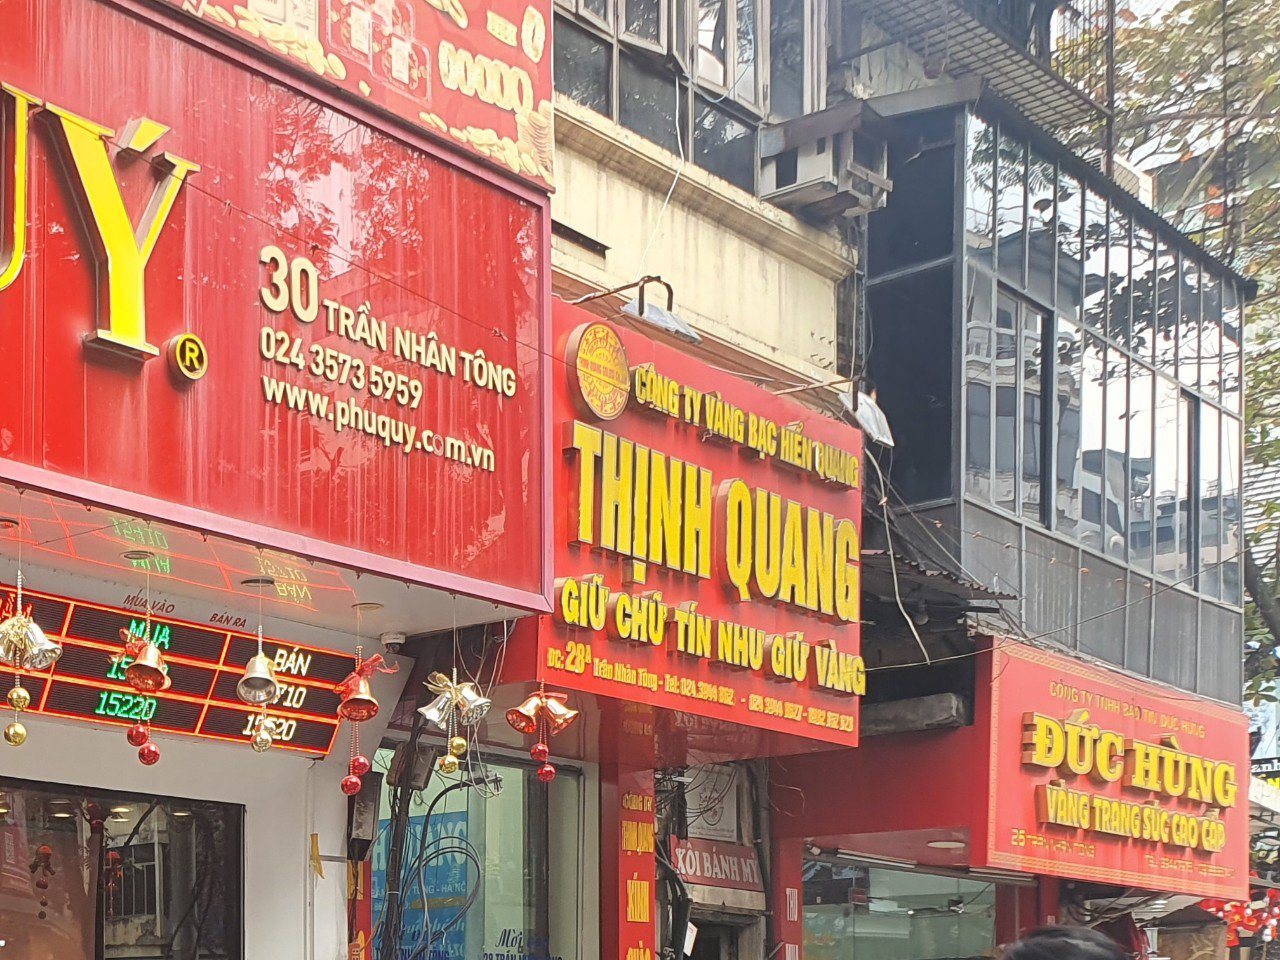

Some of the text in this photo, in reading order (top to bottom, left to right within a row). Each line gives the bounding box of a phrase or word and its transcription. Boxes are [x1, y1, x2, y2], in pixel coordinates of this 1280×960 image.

[260, 245, 319, 323] 30
[323, 299, 387, 352] TRẦN
[394, 326, 456, 377] NHÂN
[459, 349, 517, 397] TÔNG
[260, 326, 423, 410] 024 3573 5959
[262, 375, 495, 472] www.phuquy.com.vn
[635, 363, 679, 418] CÔNG
[684, 387, 705, 426] TY
[705, 391, 745, 443] VÀNG
[748, 412, 777, 460] BẠC
[815, 441, 859, 488] QUANG
[573, 420, 859, 623] THỊNH QUANG
[151, 598, 175, 614] VÀO
[209, 611, 247, 628] BÁN RA
[561, 574, 866, 696] GIỮ CHỮ TÍN NHƯ GIỮ VÀNG
[273, 646, 311, 677] BÁN
[95, 690, 157, 721] 15220
[273, 684, 307, 709] 710
[1029, 708, 1238, 808] ĐỨC HÙNG
[1093, 794, 1142, 840] TRANG
[1172, 812, 1198, 849] CAO
[675, 842, 701, 876] XÔI
[703, 846, 740, 881] BÁNH
